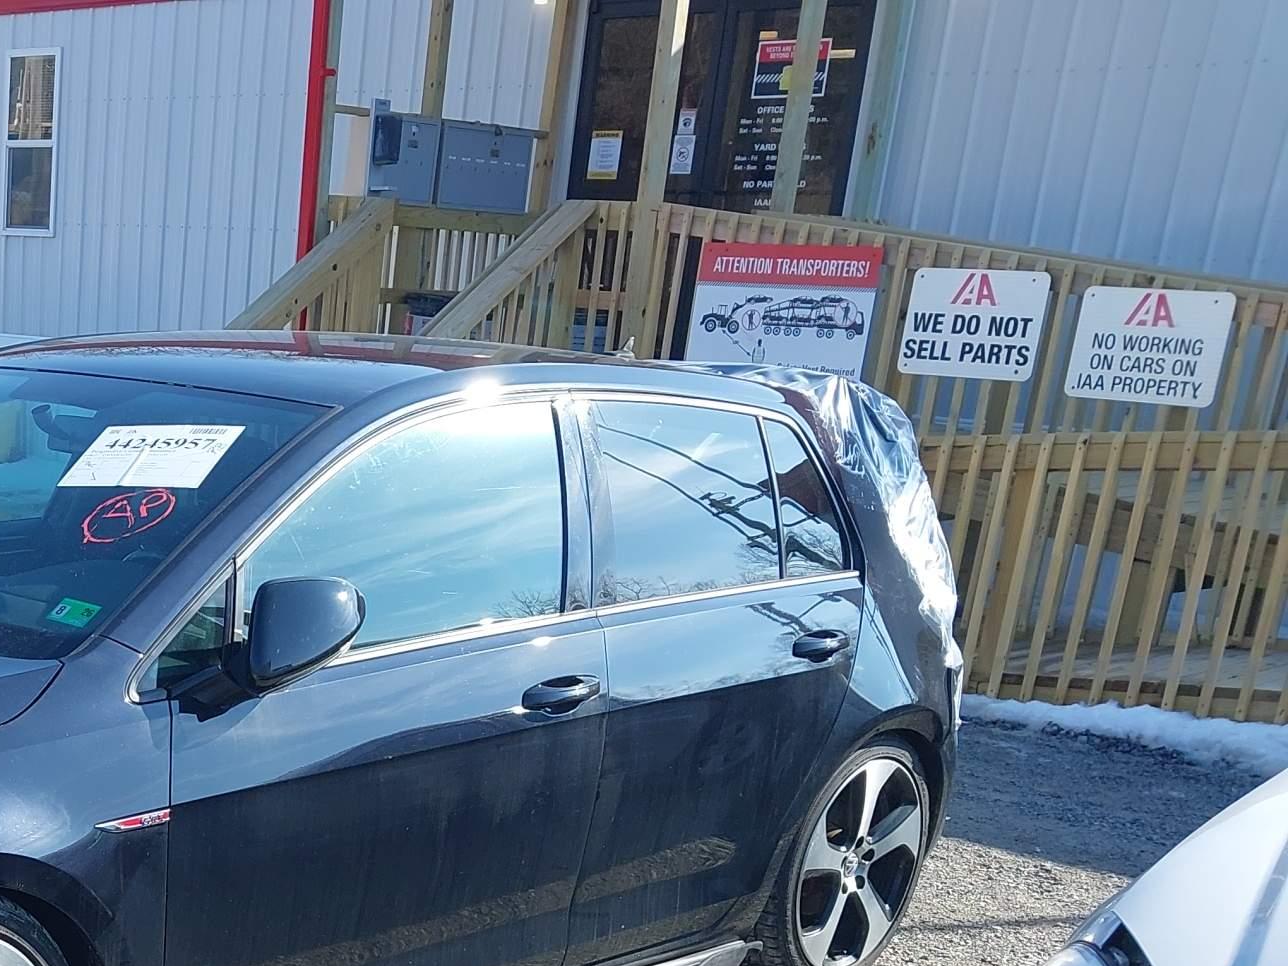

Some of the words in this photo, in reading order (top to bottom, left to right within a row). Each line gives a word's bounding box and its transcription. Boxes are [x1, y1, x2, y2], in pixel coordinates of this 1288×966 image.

[757, 106, 784, 114] OFFICE
[713, 257, 773, 274] ATTENTION
[776, 259, 870, 278] TRANSPORTERS!
[913, 312, 946, 333] WE
[951, 314, 981, 335] DO
[987, 316, 1033, 338] NOT
[903, 339, 951, 361] SELL
[959, 342, 1030, 366] PARTS
[1092, 332, 1116, 350] NO
[1123, 334, 1204, 356] WORKING
[1090, 353, 1114, 371] ON
[1120, 355, 1165, 375] CARS
[1172, 359, 1197, 377] ON
[1077, 373, 1105, 391] IAA
[1111, 375, 1203, 399] PROPERTY
[105, 438, 217, 450] 44245957
[56, 605, 66, 615] 8
